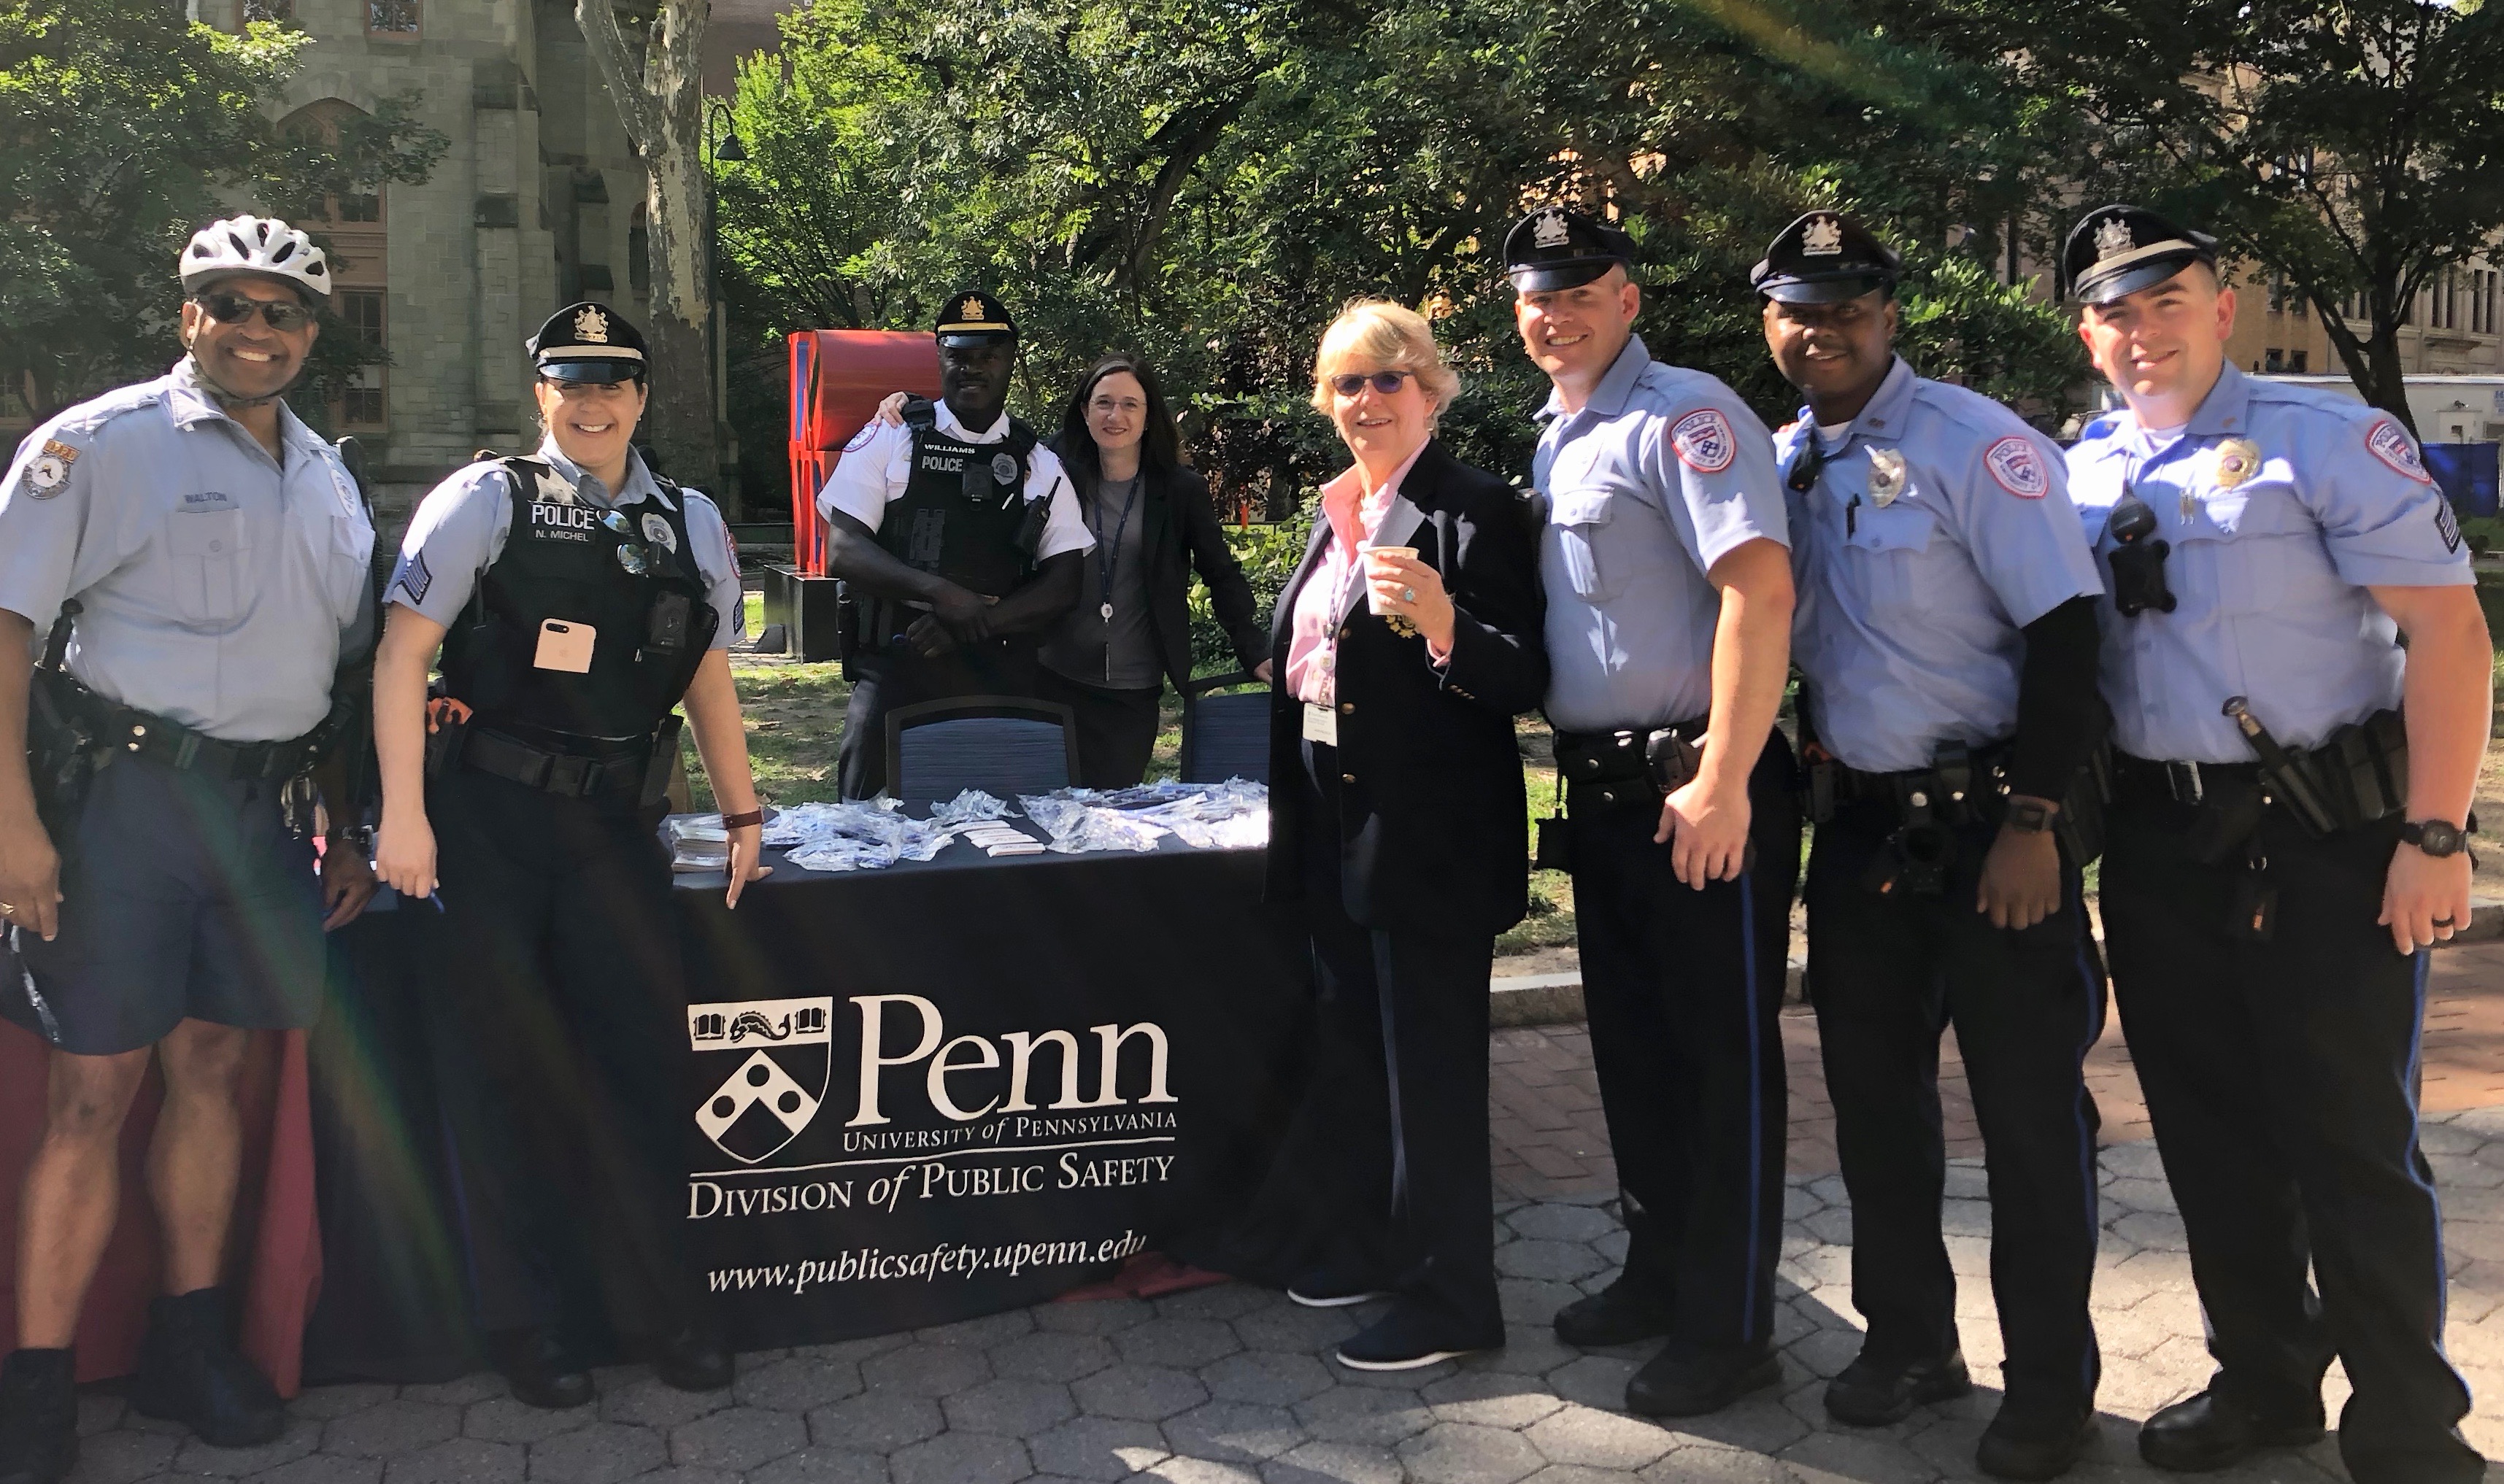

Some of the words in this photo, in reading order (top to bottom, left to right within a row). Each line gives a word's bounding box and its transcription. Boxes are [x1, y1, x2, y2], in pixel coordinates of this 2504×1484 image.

[1677, 414, 1717, 432] POLICE
[924, 444, 976, 454] WILLIAMS
[921, 455, 963, 472] POLICE
[185, 492, 227, 503] WALTON
[531, 504, 595, 530] POLICE
[535, 530, 547, 538] N.
[550, 530, 589, 542] MICHEL
[844, 994, 1179, 1127] Penn
[844, 1126, 975, 1152] UNIVERSITY
[982, 1118, 1009, 1145] of
[1016, 1112, 1177, 1138] PENNSYLVANIA
[687, 1182, 854, 1219] DIVISION
[867, 1165, 917, 1213] of
[920, 1163, 1044, 1199] PUBLIC
[1058, 1153, 1174, 1189] SAFETY
[709, 1229, 1147, 1295] www.publicsafety.upenn.edu
